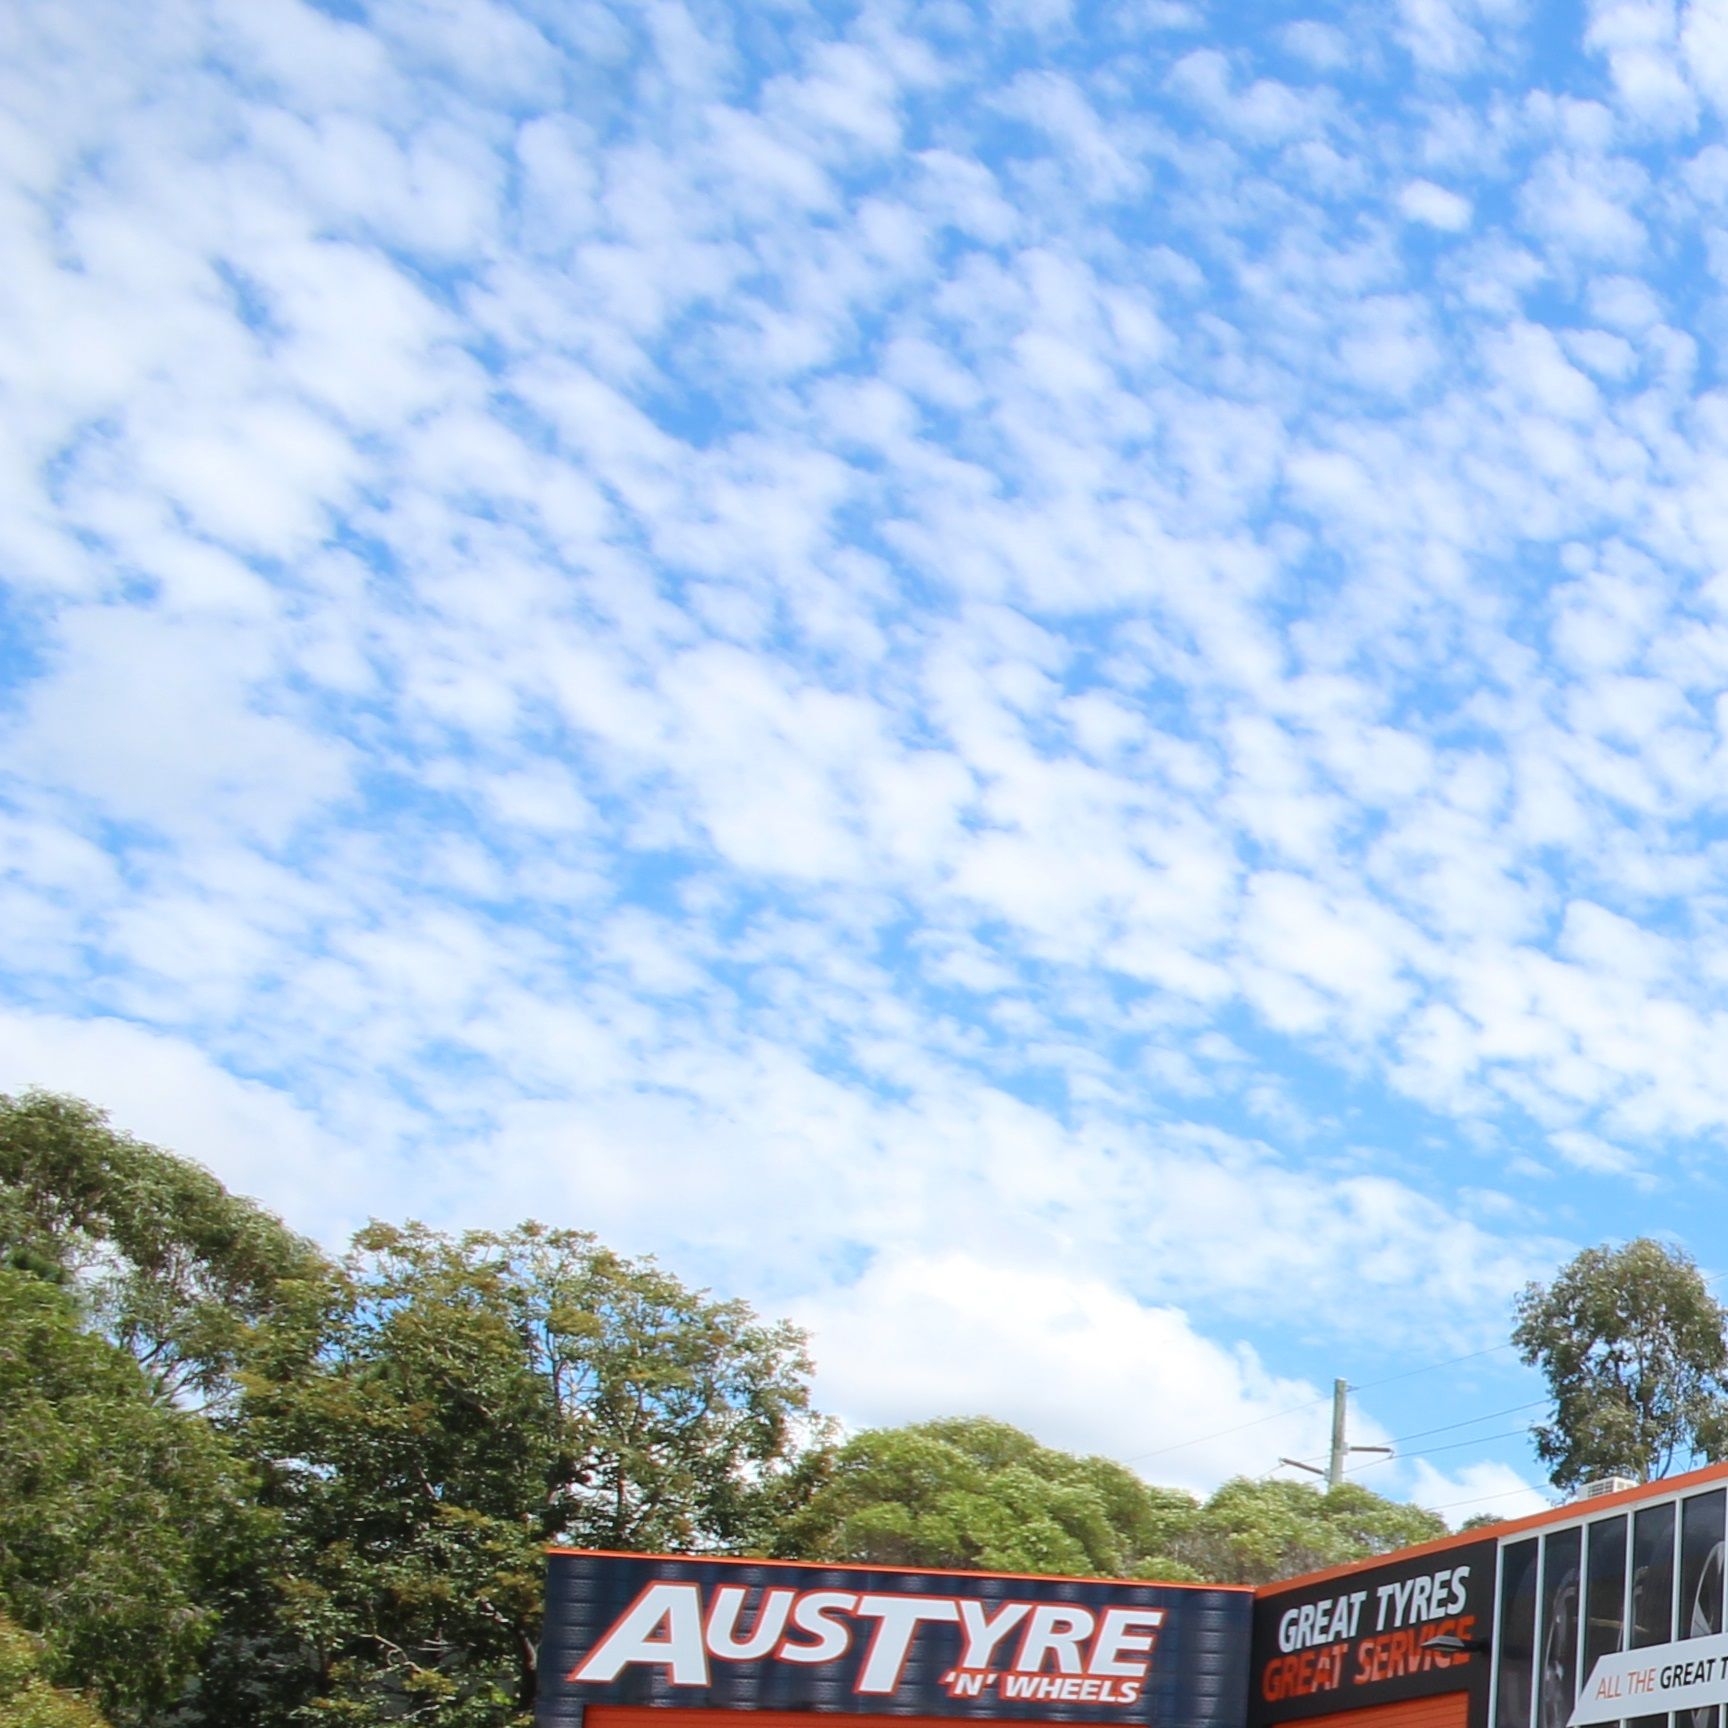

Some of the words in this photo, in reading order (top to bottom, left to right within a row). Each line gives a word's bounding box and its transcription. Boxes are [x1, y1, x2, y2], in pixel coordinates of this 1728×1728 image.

[570, 1582, 1164, 1694] AUSTYRE
[1278, 1591, 1367, 1653] GREAT
[1375, 1565, 1471, 1632] TYRES
[1004, 1675, 1141, 1703] WHEELS
[1262, 1643, 1349, 1701] GREAT
[1353, 1615, 1476, 1685] SERVICE
[1594, 1676, 1621, 1700] ALL
[1627, 1668, 1657, 1693] THE
[1660, 1658, 1716, 1690] GREAT
